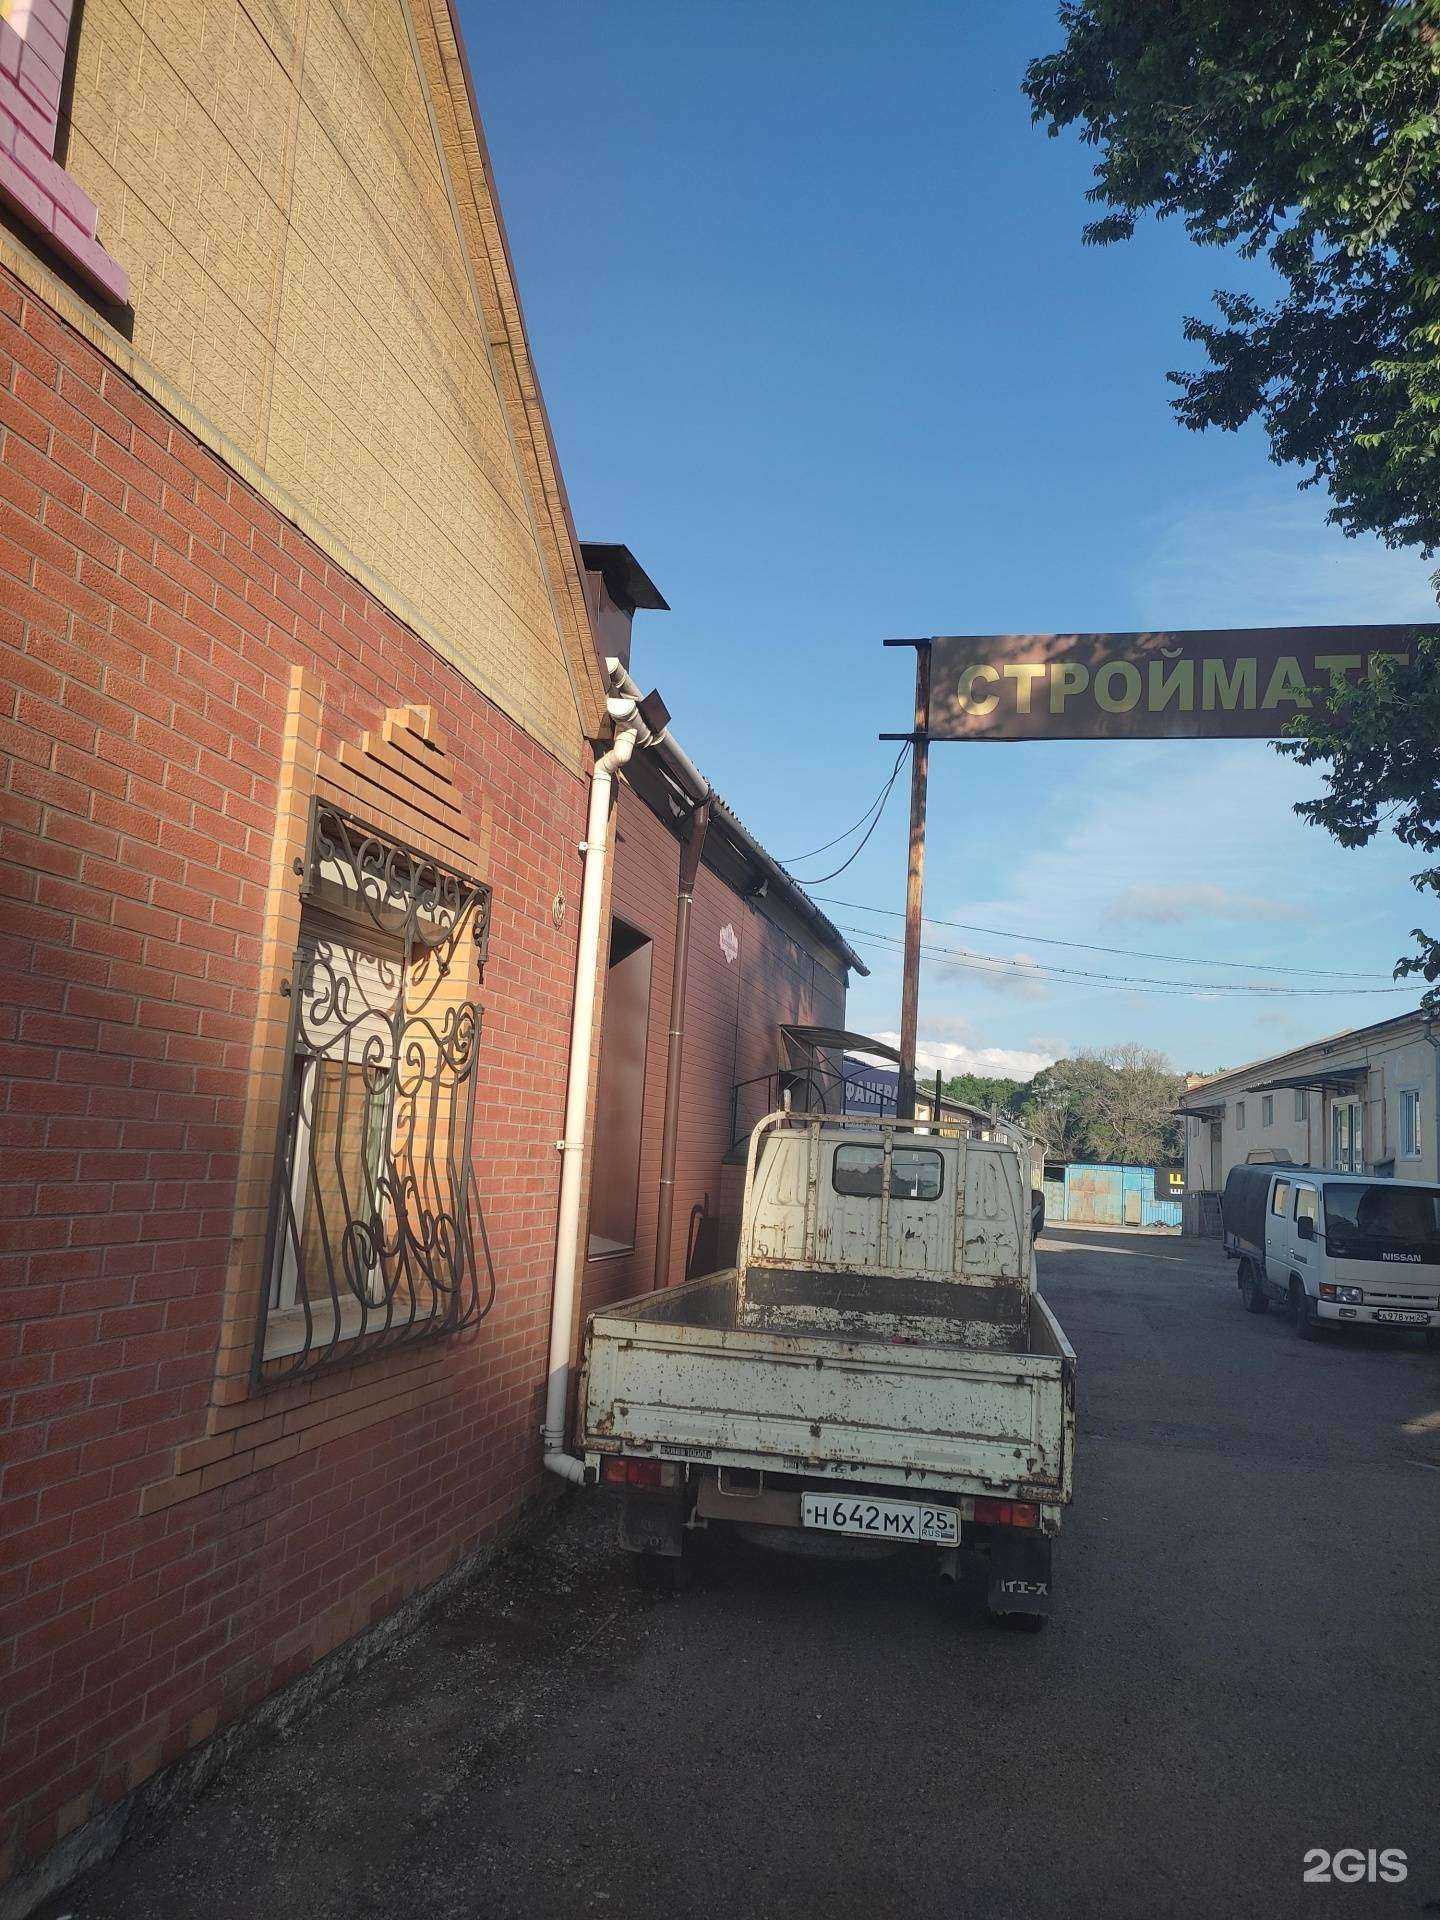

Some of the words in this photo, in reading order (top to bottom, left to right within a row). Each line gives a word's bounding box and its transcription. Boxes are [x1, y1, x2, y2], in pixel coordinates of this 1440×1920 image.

[1382, 1252, 1421, 1262] NISSAN
[814, 1502, 915, 1535] Н642МХ
[923, 1510, 948, 1530] 25
[921, 1528, 941, 1538] RUS
